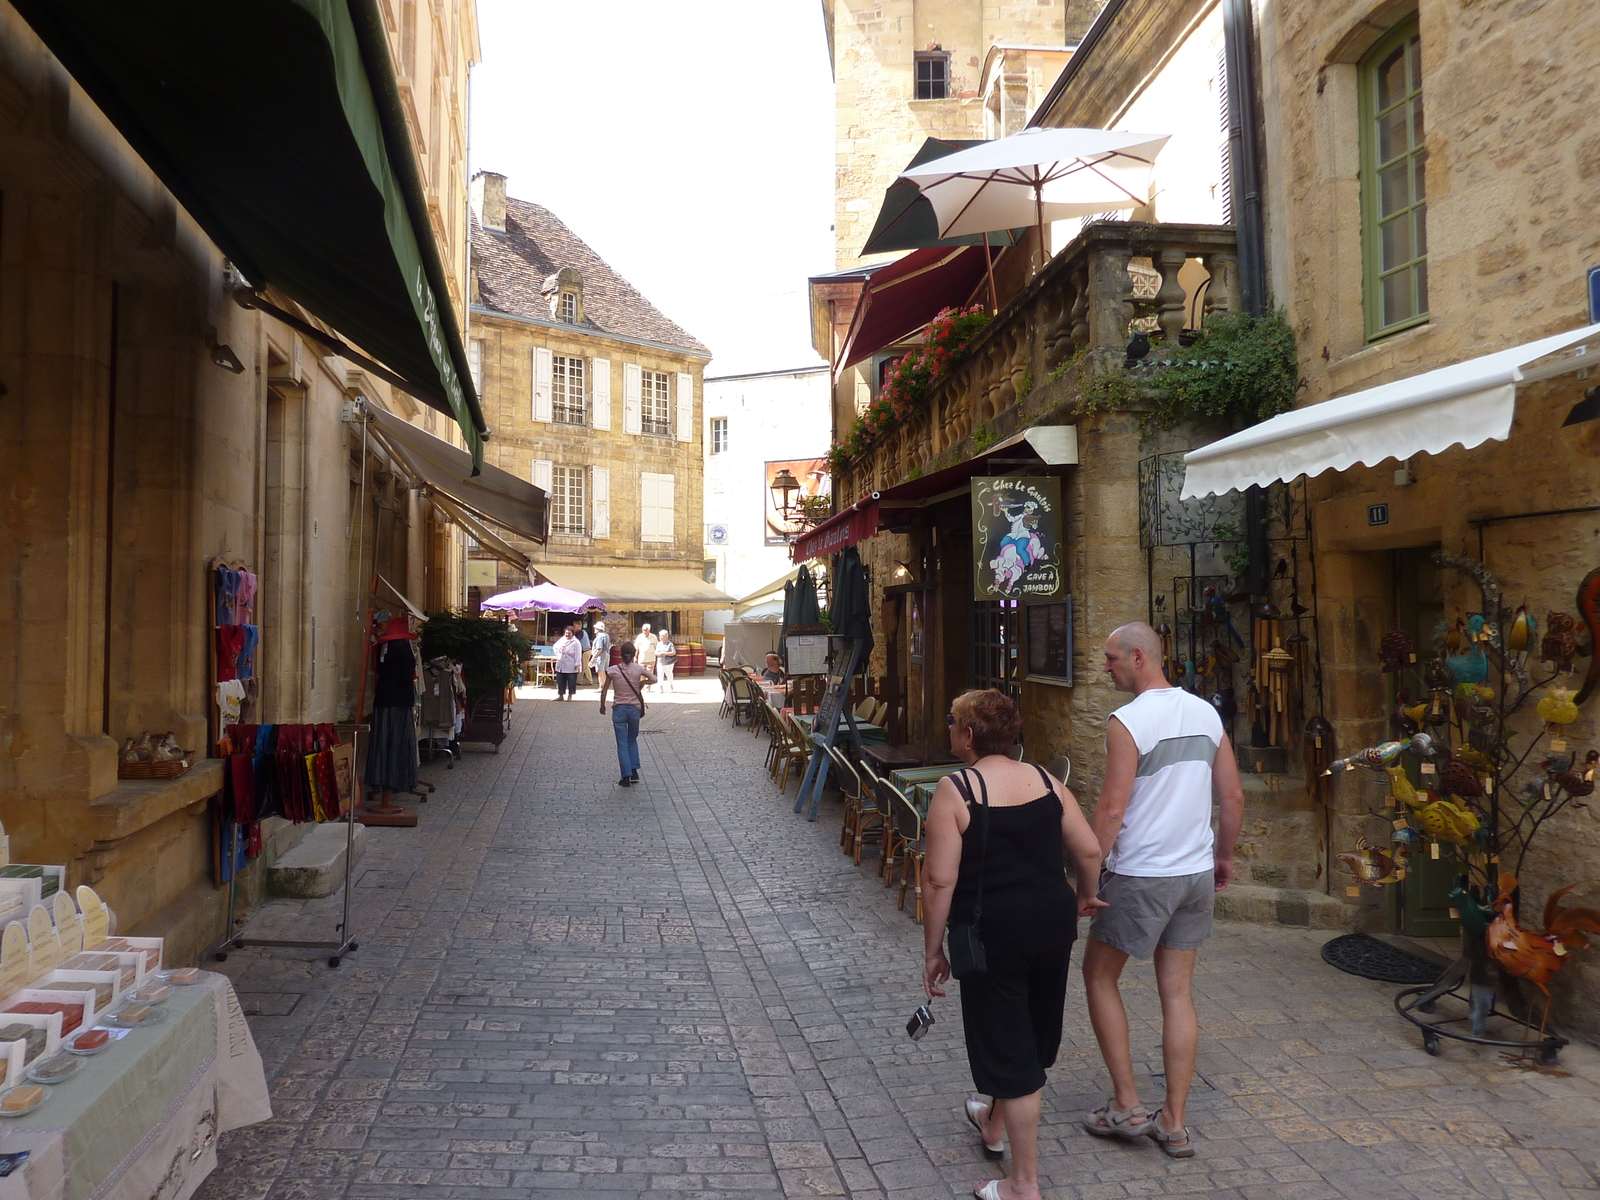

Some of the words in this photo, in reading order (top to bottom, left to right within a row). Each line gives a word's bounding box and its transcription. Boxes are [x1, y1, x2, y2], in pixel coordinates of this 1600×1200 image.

[993, 480, 1013, 491] Chez
[1015, 480, 1025, 492] Le
[1027, 486, 1052, 513] Gaulois
[1373, 507, 1383, 521] 11
[1027, 573, 1047, 581] CAVE
[1022, 584, 1055, 593] JAMBON
